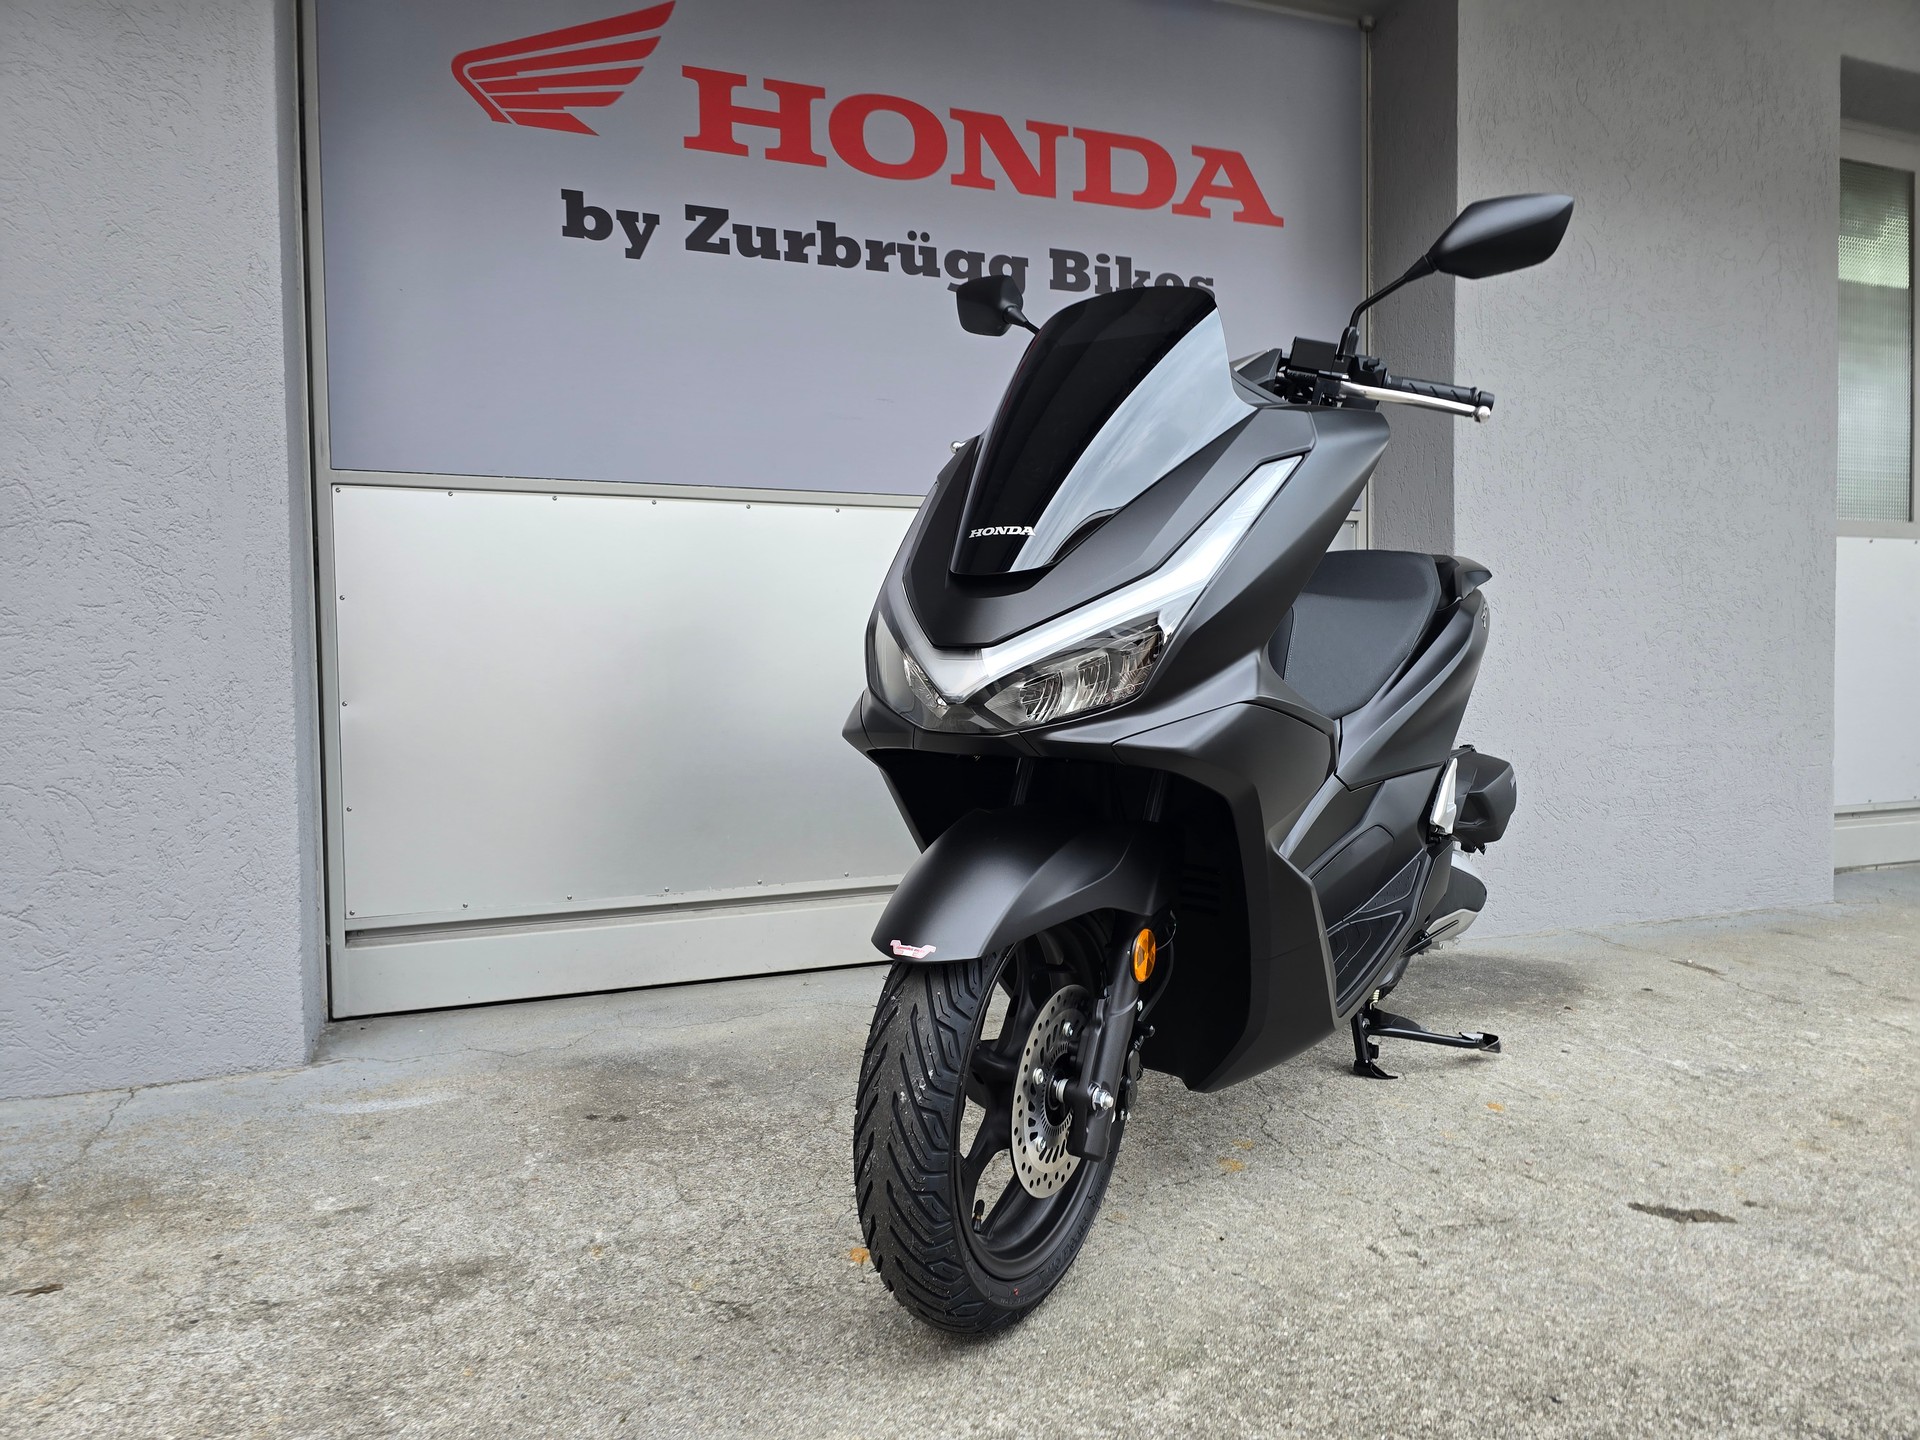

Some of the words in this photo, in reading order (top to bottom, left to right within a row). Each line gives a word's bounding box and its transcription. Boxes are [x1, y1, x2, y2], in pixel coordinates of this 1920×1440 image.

[681, 64, 1285, 228] HONDA
[561, 188, 660, 260] by
[684, 203, 1029, 296] Zurbrügg
[968, 526, 1036, 538] HONDA
